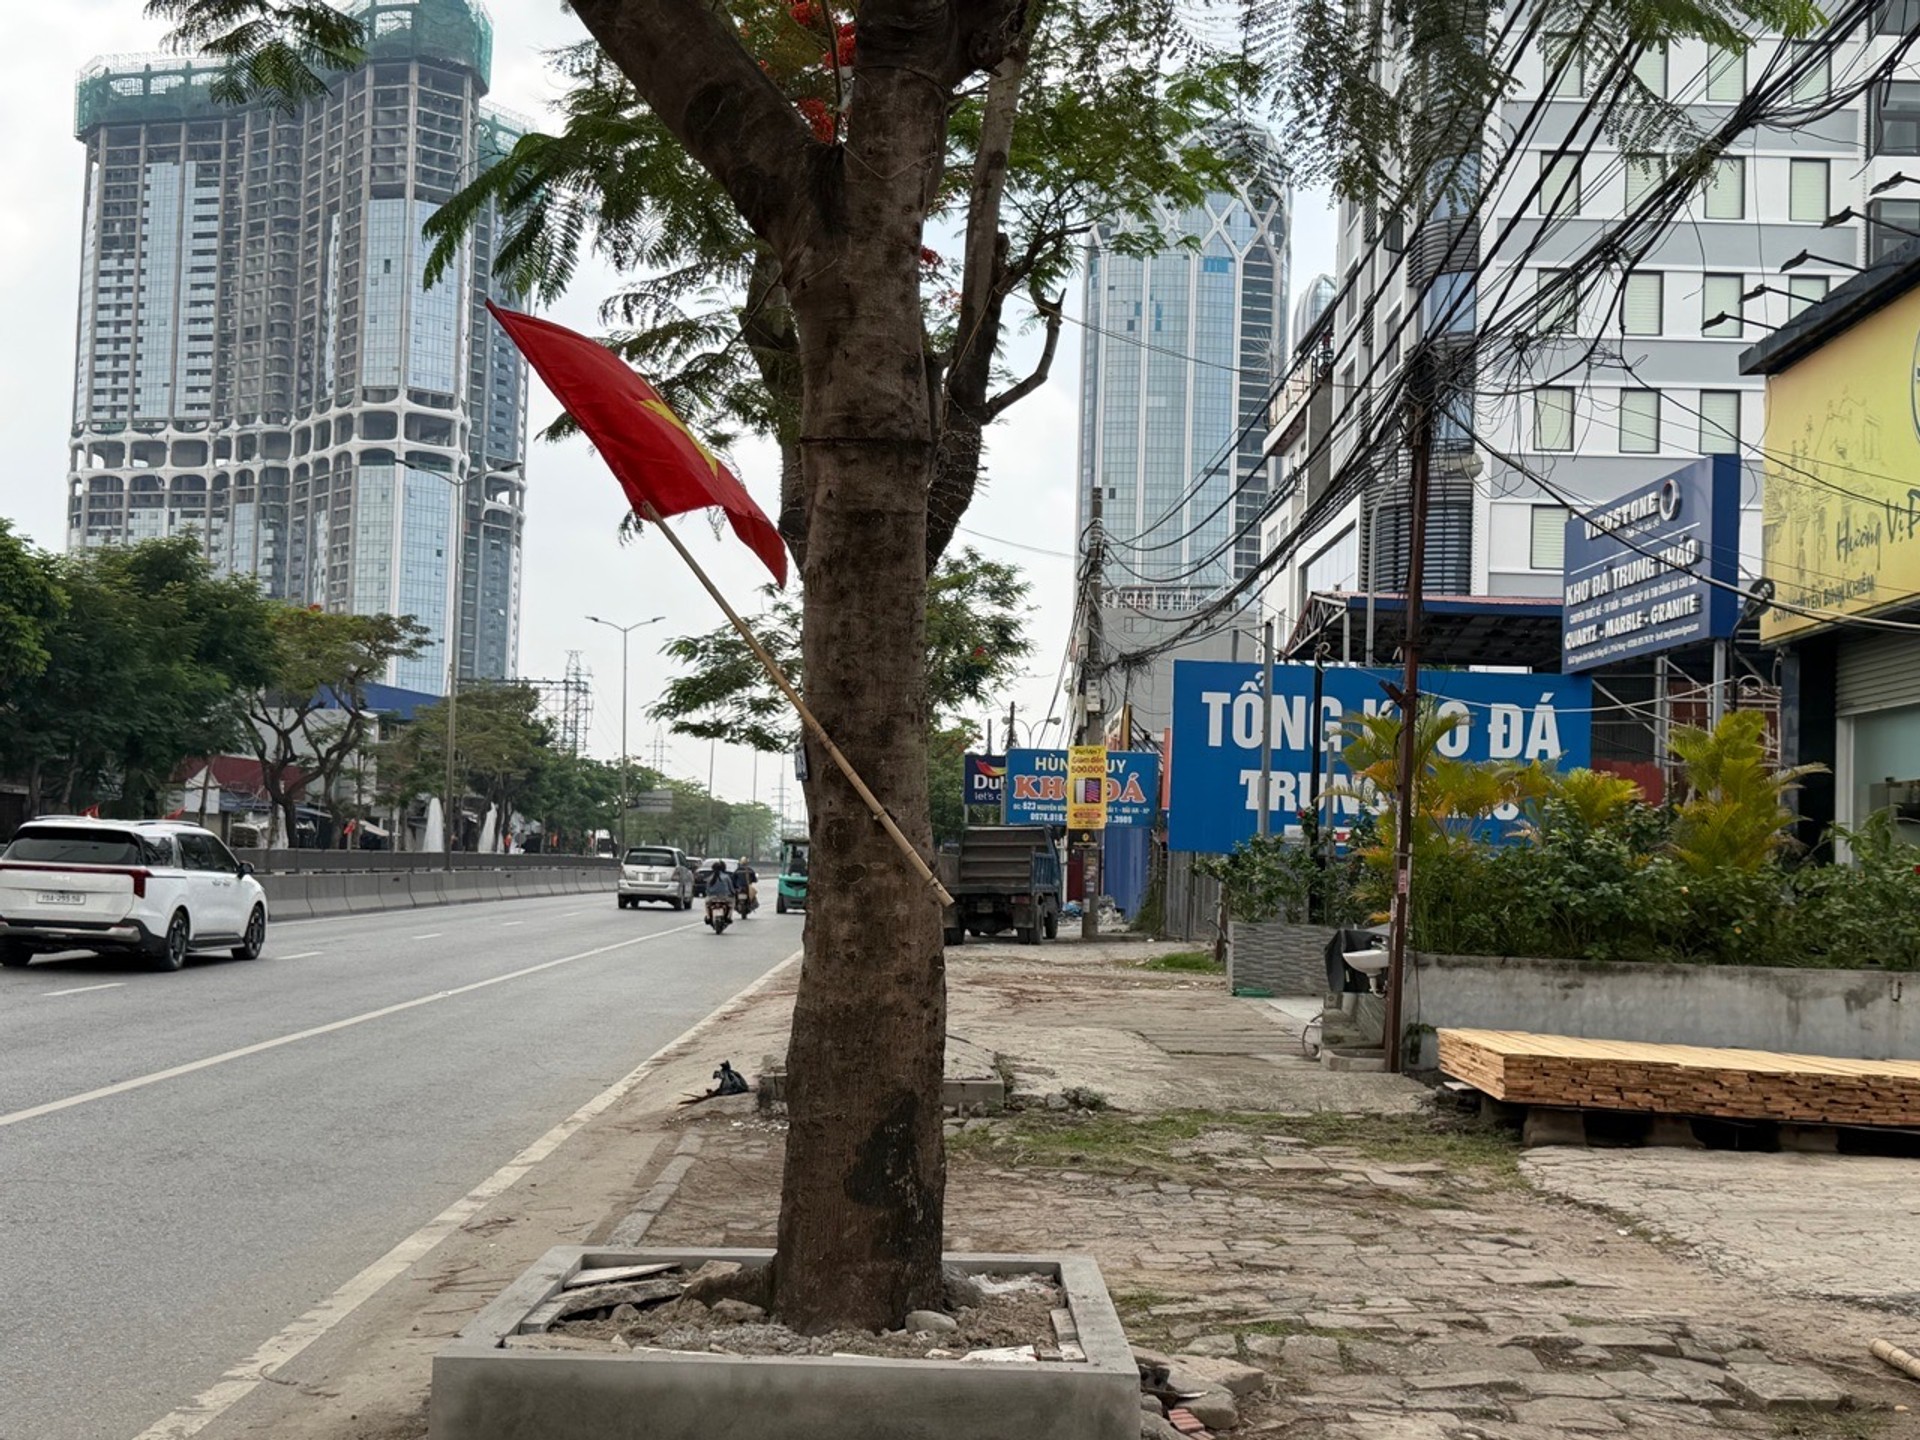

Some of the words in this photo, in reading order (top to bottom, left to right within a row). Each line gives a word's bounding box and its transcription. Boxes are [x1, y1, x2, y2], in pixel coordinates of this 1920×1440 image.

[1566, 579, 1589, 607] KHO
[1591, 565, 1610, 597] ĐÁ
[1611, 555, 1656, 590] TRUNG
[1564, 624, 1598, 651] QUARTZ
[1605, 610, 1643, 638] MARBLE
[1650, 593, 1697, 625] GRANITE
[1202, 671, 1343, 753] TỔNG
[1362, 697, 1470, 758] KO
[1488, 692, 1562, 759] ĐÁ
[973, 773, 1005, 790] Dul
[1034, 753, 1068, 772] HÙN
[1107, 759, 1127, 774] UY
[1012, 774, 1068, 801] KH
